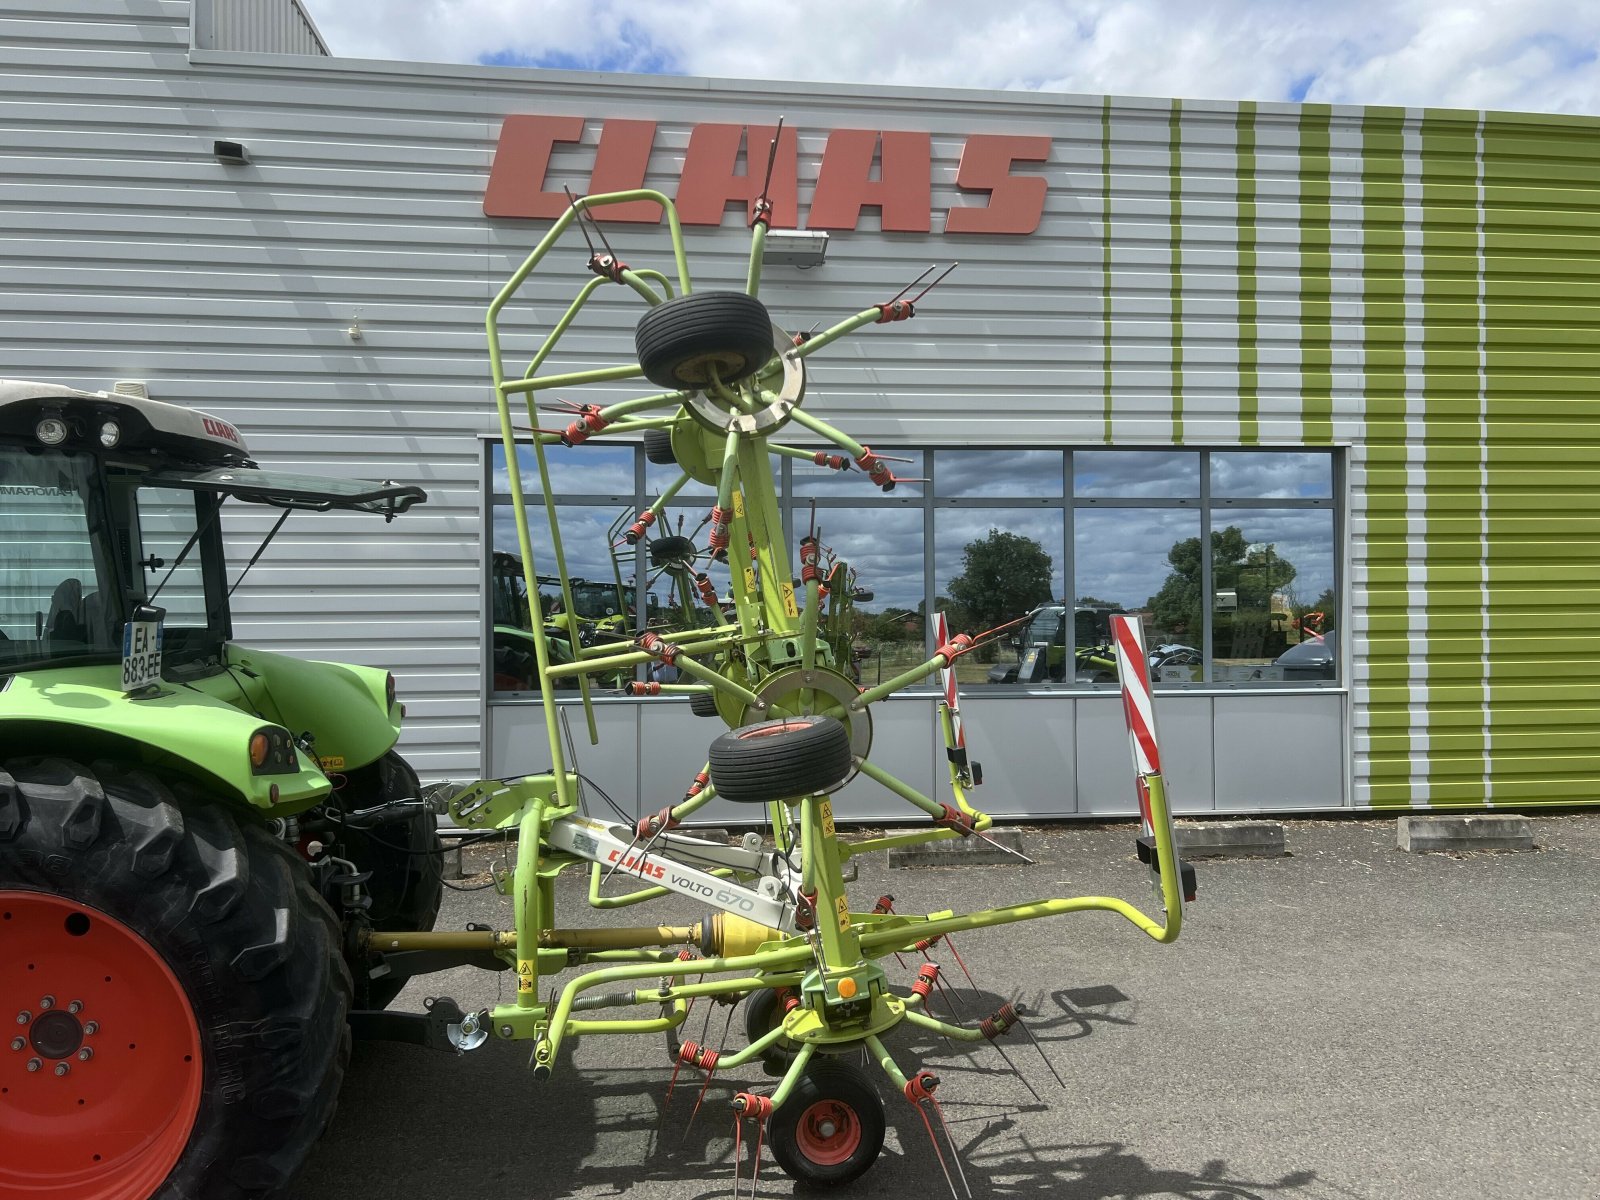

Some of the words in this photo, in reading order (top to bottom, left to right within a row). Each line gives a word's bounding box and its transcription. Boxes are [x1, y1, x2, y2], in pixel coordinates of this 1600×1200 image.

[484, 115, 1052, 235] CLAAS
[203, 418, 239, 443] CLAAS
[123, 652, 161, 685] 883-EE
[671, 873, 714, 898] VOLTO
[715, 888, 755, 913] 670
